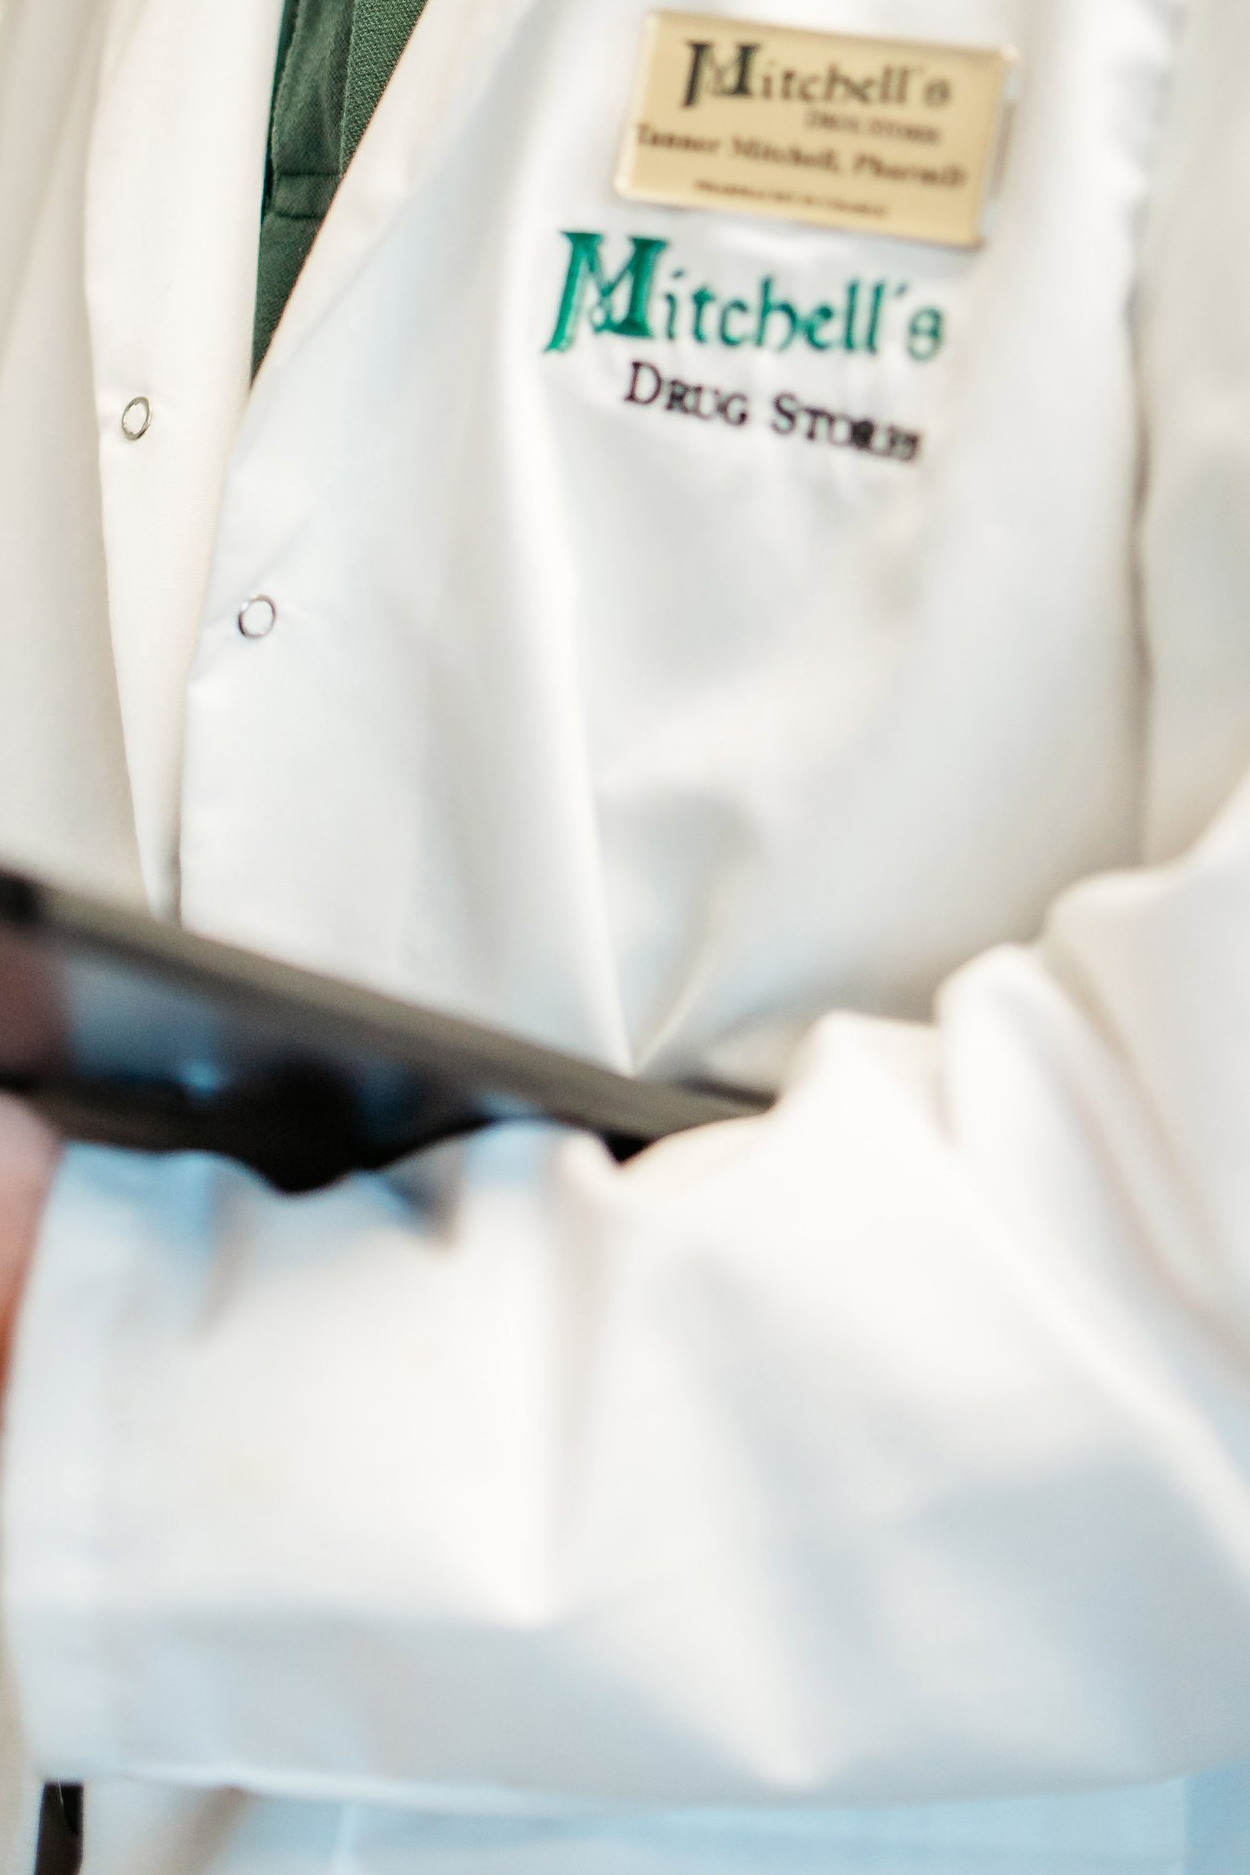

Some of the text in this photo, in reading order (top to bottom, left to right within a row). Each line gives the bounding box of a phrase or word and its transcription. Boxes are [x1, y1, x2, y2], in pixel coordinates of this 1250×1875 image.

[680, 39, 953, 111] Mitchell's
[543, 230, 946, 363] Mitchell's
[624, 359, 749, 427] DRUG
